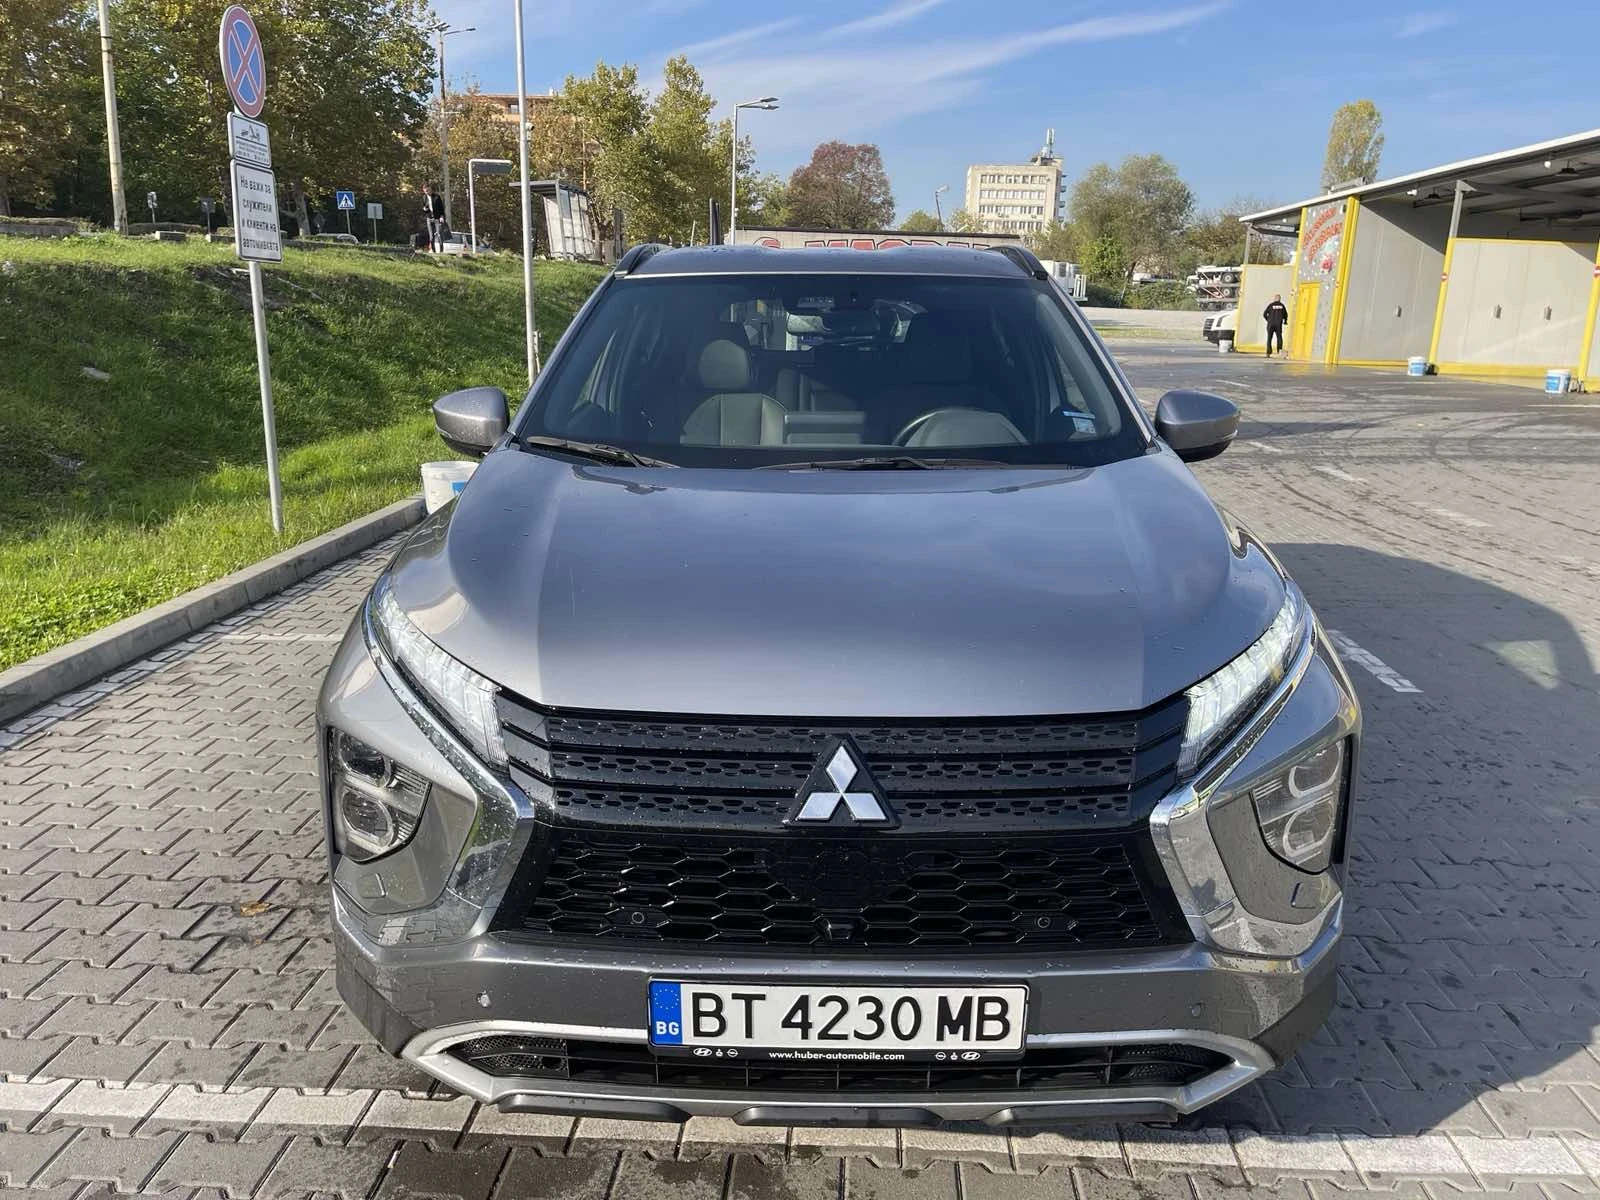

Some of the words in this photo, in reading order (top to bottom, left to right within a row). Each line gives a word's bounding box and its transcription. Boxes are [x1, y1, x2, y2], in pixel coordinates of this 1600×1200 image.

[241, 176, 248, 189] Не
[249, 180, 264, 193] важи
[264, 184, 272, 194] за
[242, 199, 272, 213] служители
[246, 219, 269, 231] клиенти
[269, 223, 277, 232] на
[242, 238, 279, 252] автомивката
[692, 992, 767, 1039] BT
[781, 994, 922, 1041] 4230
[936, 996, 1011, 1042] MB
[655, 1021, 680, 1036] BG
[768, 1051, 905, 1061] www.huber-automobile.com
